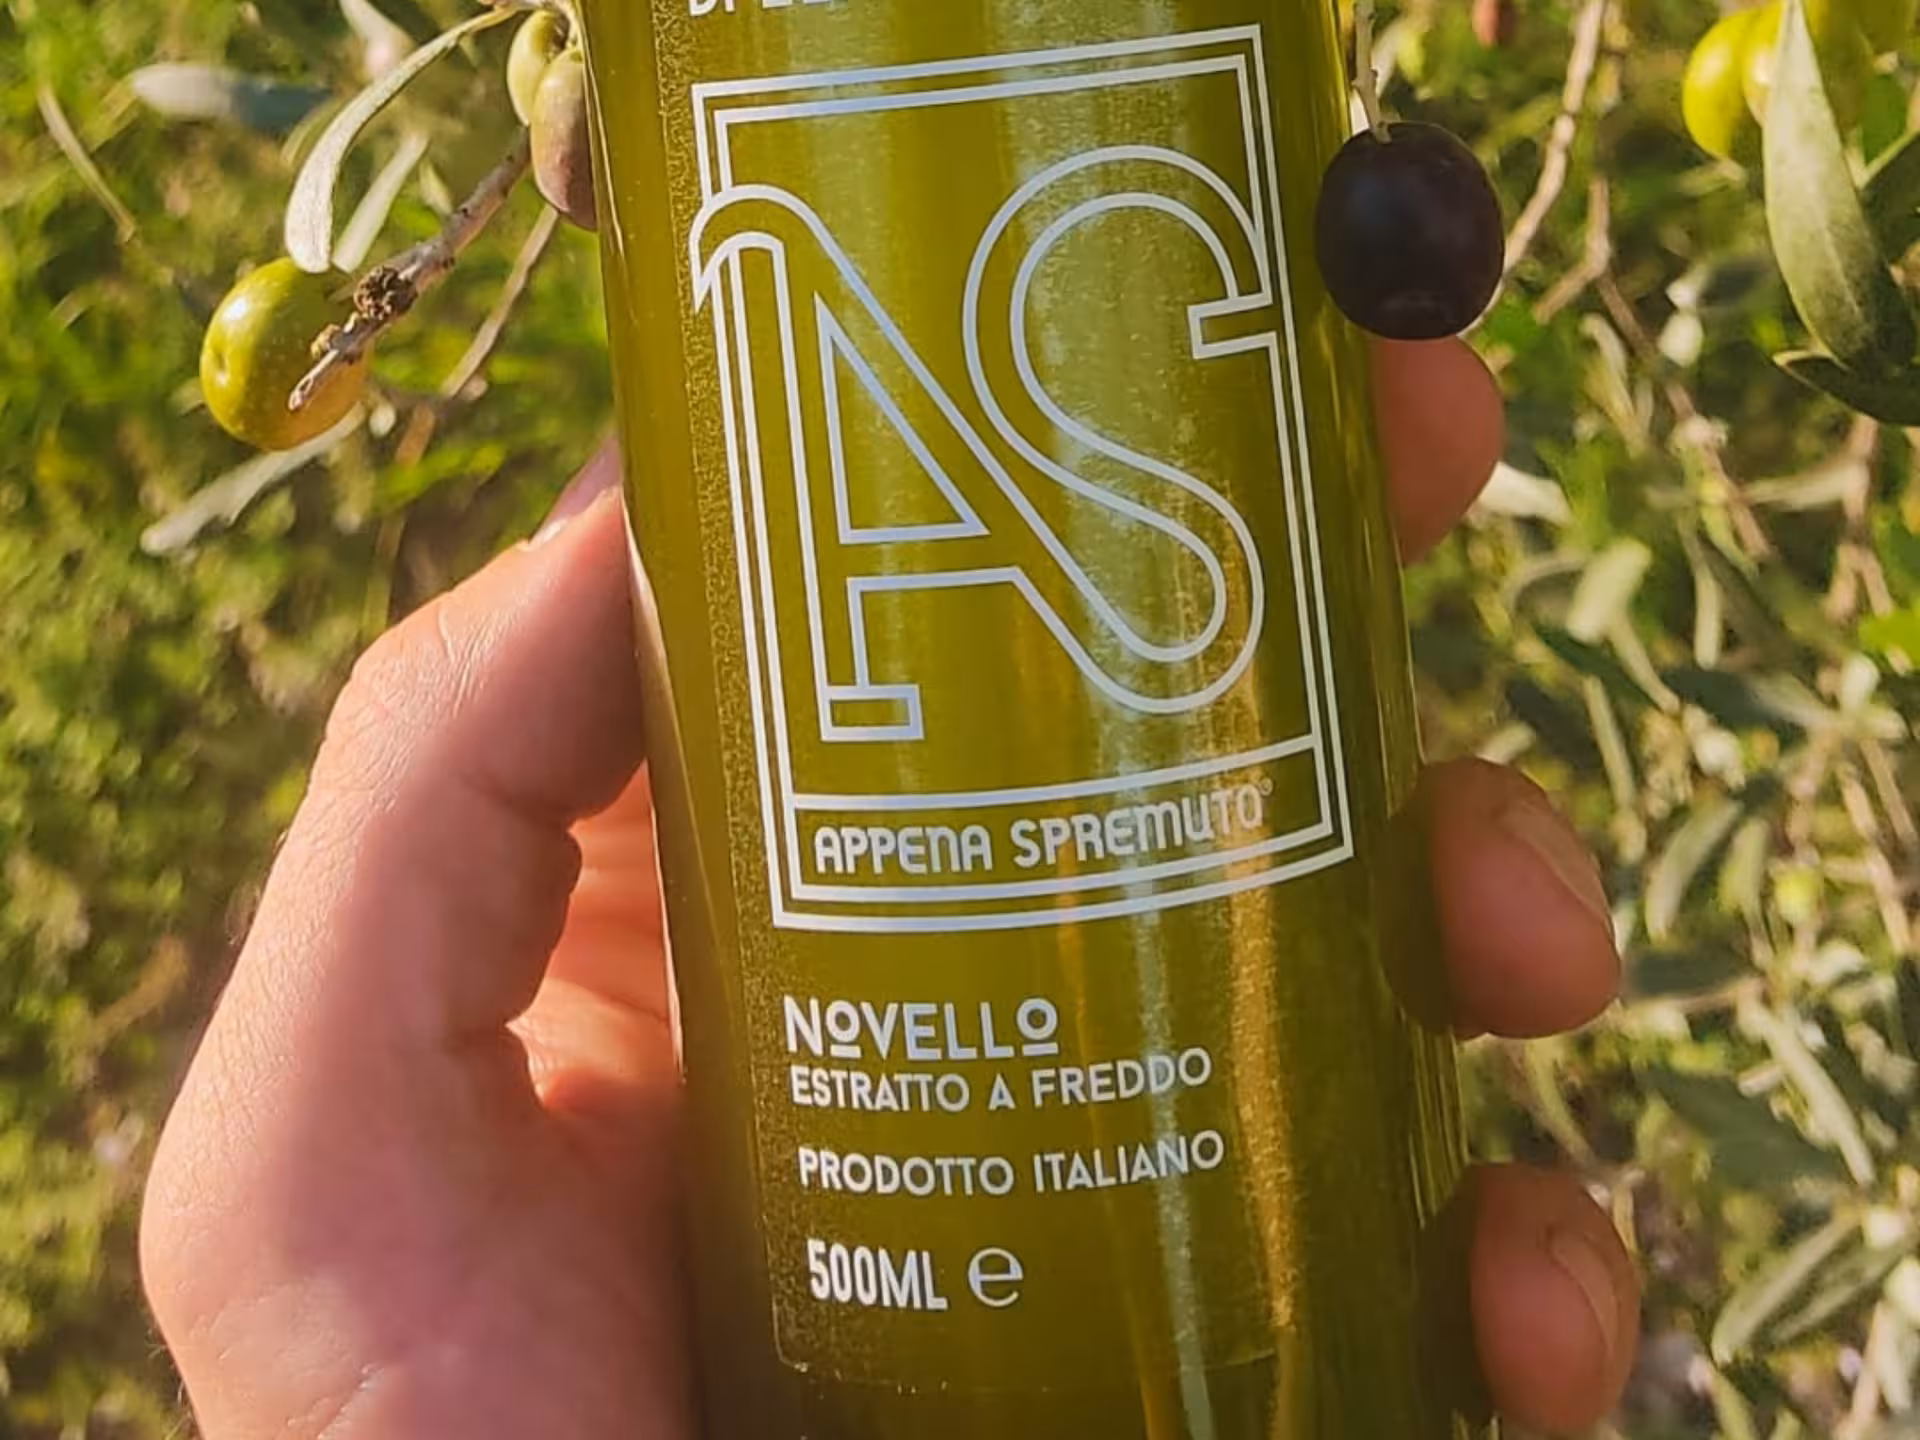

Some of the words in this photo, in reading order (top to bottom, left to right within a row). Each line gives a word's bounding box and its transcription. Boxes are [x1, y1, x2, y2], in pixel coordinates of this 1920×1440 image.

[814, 825, 993, 875] APPENA
[790, 1064, 970, 1112] ESTRATTO
[988, 1074, 1016, 1111] A
[1031, 1047, 1212, 1108] FREDDO
[799, 1145, 1015, 1196] PRODOTTO
[1033, 1129, 1225, 1194] ITALIANO
[807, 1236, 949, 1310] 500ML
